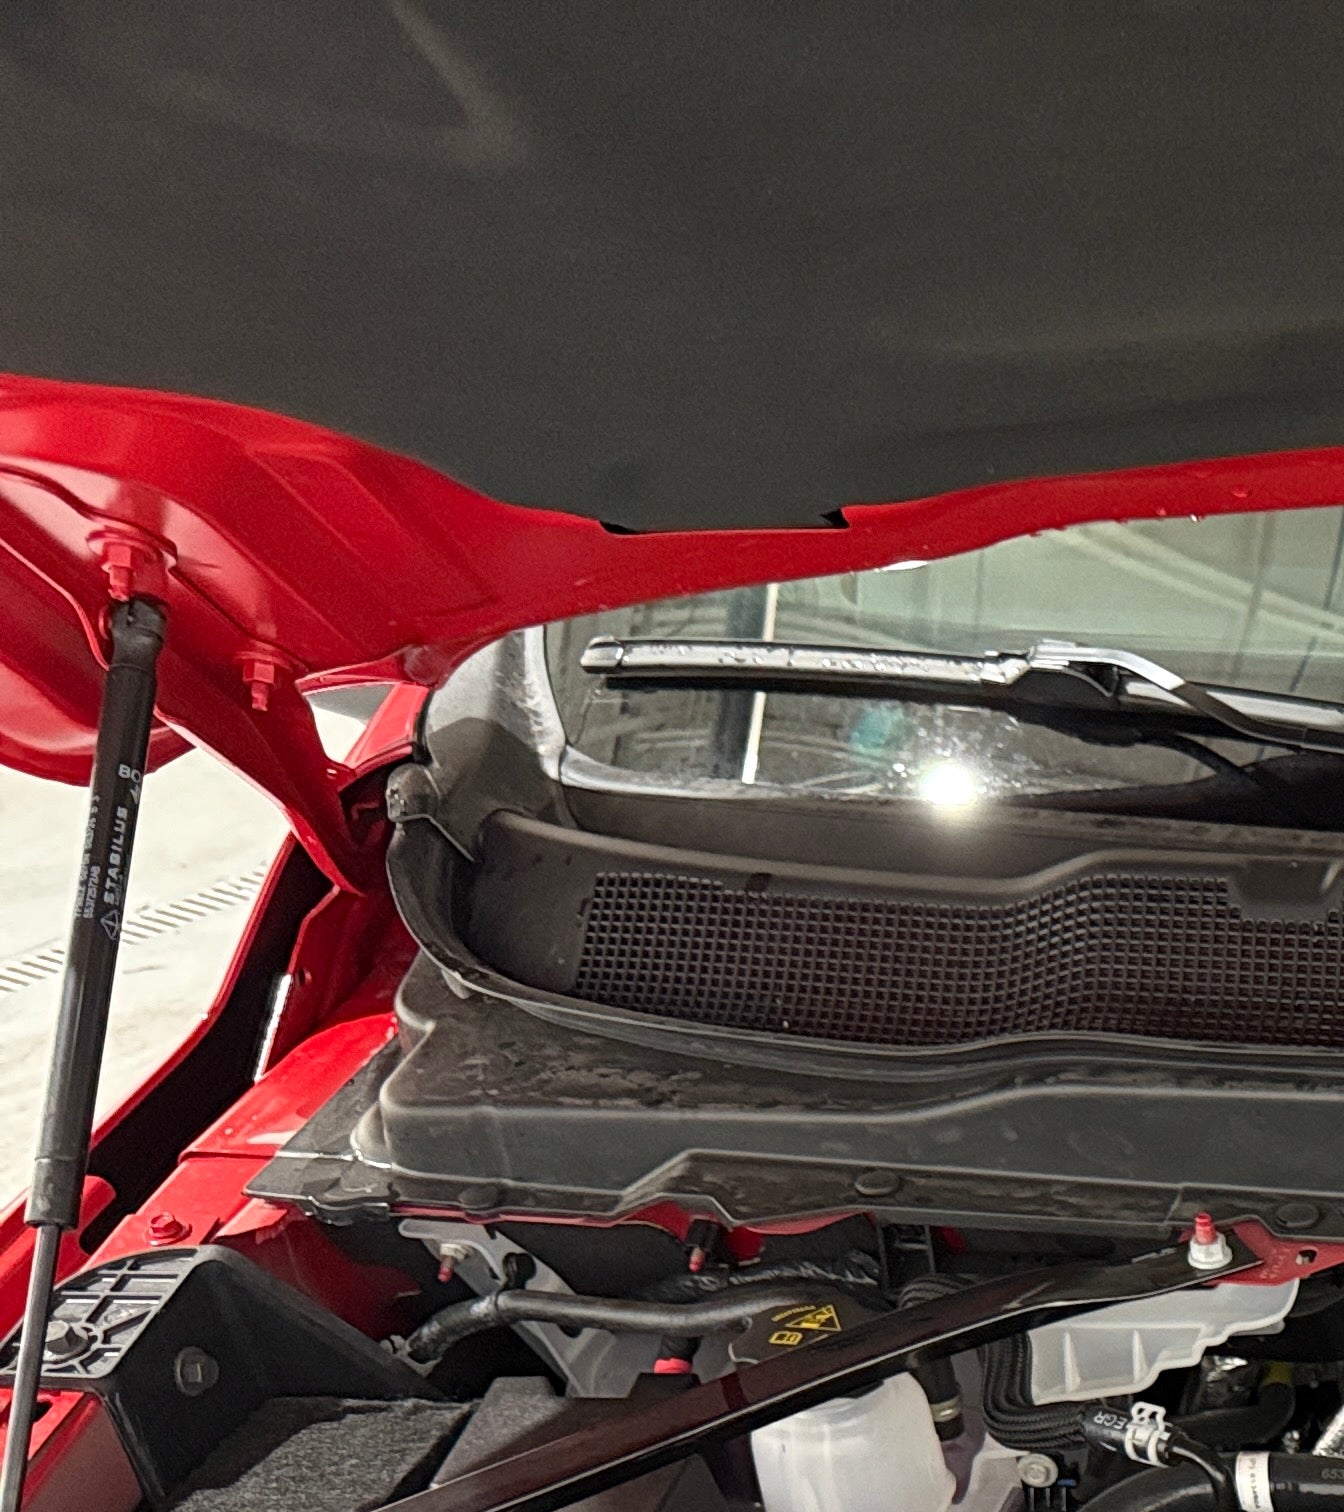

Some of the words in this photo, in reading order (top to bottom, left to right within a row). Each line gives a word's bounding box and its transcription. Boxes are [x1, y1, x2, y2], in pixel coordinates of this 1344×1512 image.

[118, 763, 141, 783] BO
[104, 805, 128, 905] STABILUS
[1094, 1411, 1128, 1429] EGR
